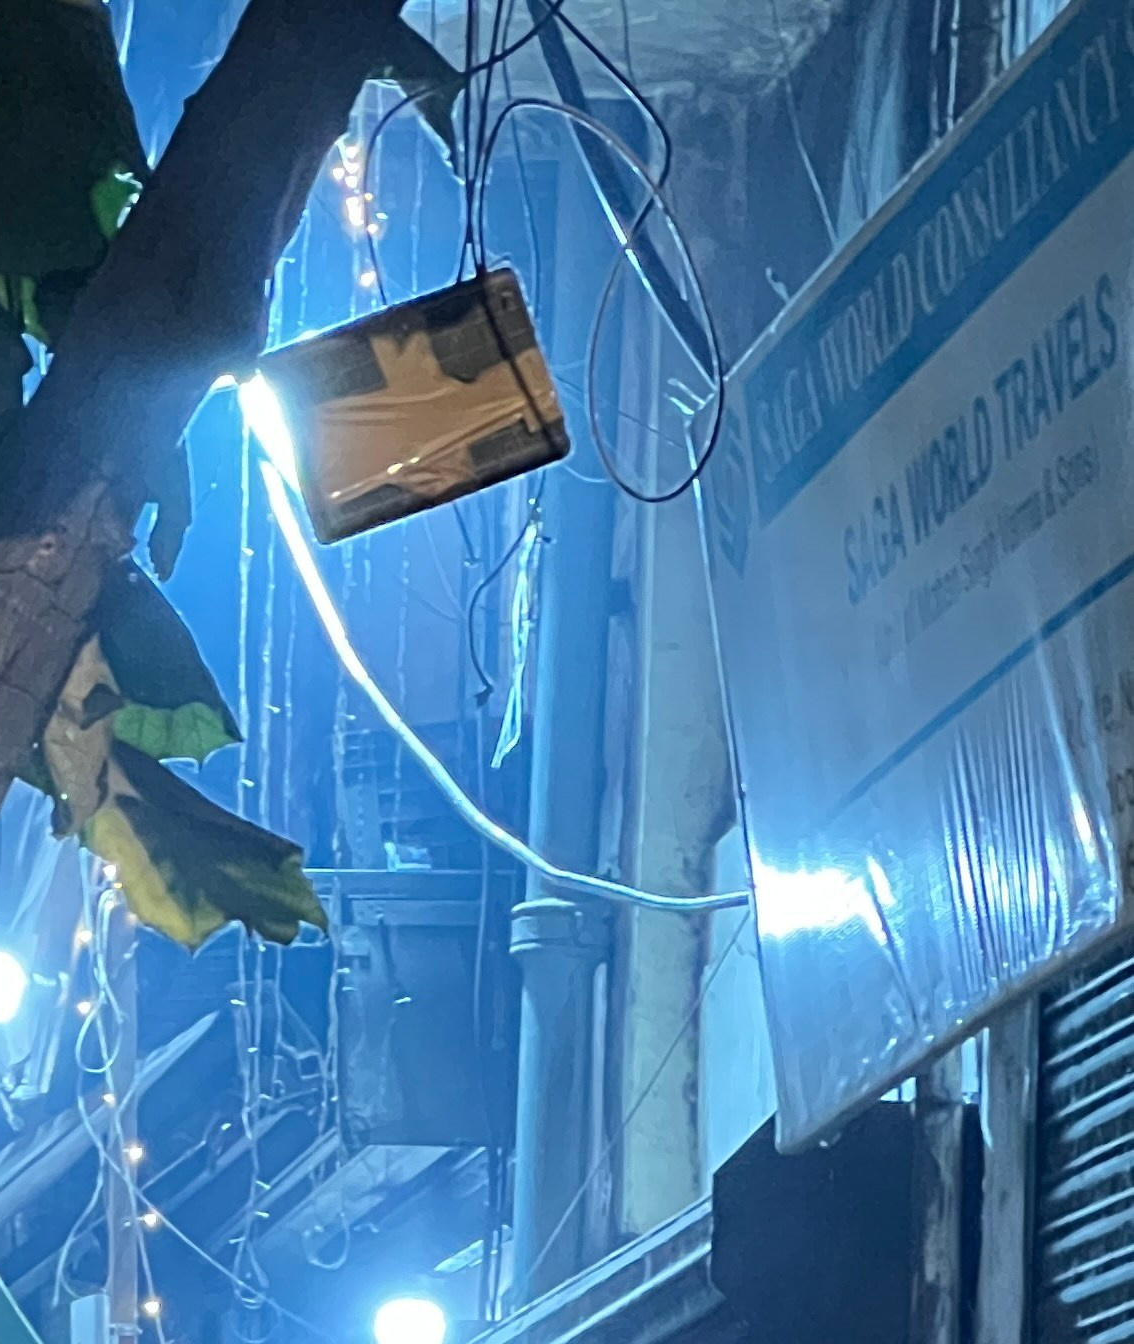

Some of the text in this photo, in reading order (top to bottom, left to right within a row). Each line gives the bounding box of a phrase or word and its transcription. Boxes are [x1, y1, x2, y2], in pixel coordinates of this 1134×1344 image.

[818, 252, 913, 404] WORLD
[917, 19, 1120, 316] CONSULTANCY
[843, 482, 908, 606] SAGA
[905, 396, 993, 545] WORLD
[993, 272, 1117, 461] TRAVELS
